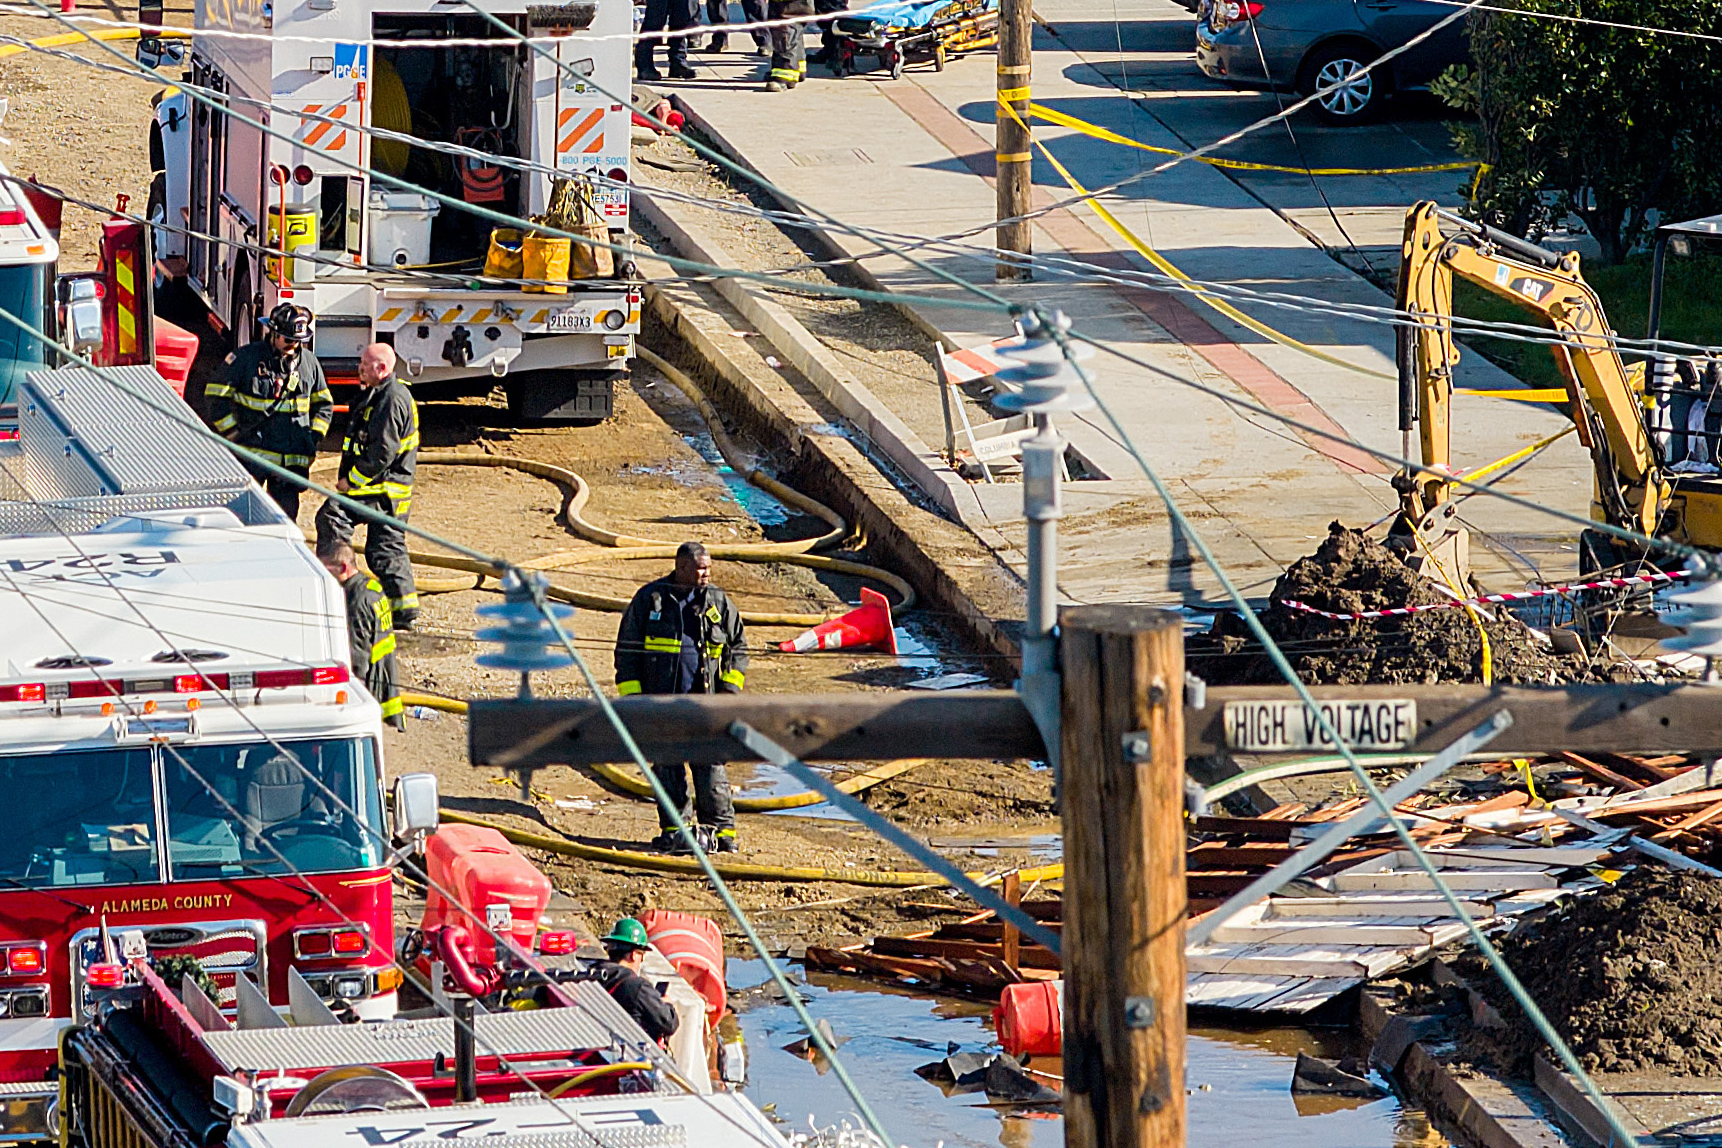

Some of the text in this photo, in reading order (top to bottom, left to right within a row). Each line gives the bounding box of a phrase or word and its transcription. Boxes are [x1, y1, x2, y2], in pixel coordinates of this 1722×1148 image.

[336, 65, 366, 79] PG&E
[1522, 278, 1544, 302] CAT
[1235, 703, 1408, 746] HIGH VOLTAGE
[101, 893, 233, 914] ALAMEDA COUNTY
